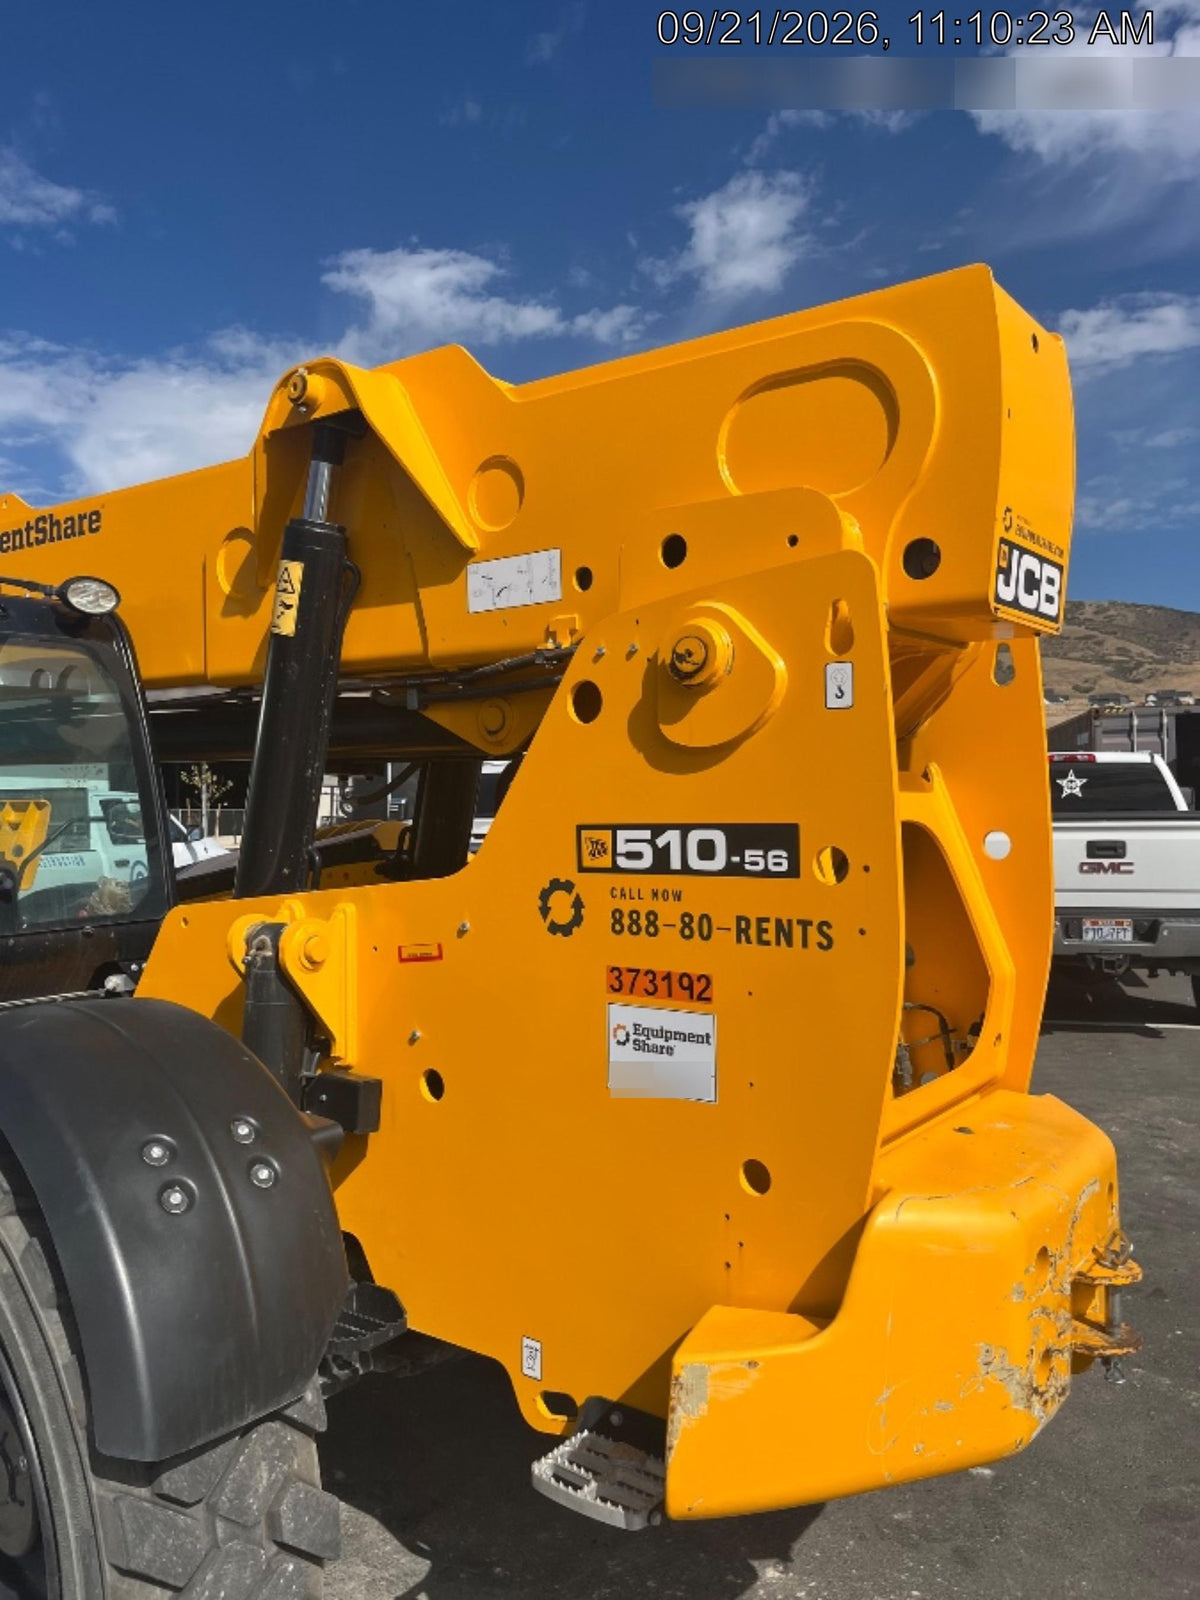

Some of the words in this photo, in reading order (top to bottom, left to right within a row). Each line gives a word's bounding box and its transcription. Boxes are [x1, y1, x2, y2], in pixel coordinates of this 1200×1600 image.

[0, 509, 102, 554] entShare
[997, 548, 1061, 618] JCB
[615, 828, 790, 873] 510-56
[1078, 861, 1135, 875] GMC
[610, 886, 645, 901] CALL
[651, 888, 683, 903] NOW
[610, 907, 835, 952] 888-80-RENTS
[608, 966, 713, 1003] 373192
[632, 1022, 712, 1046] Equipment
[632, 1039, 676, 1057] Share
